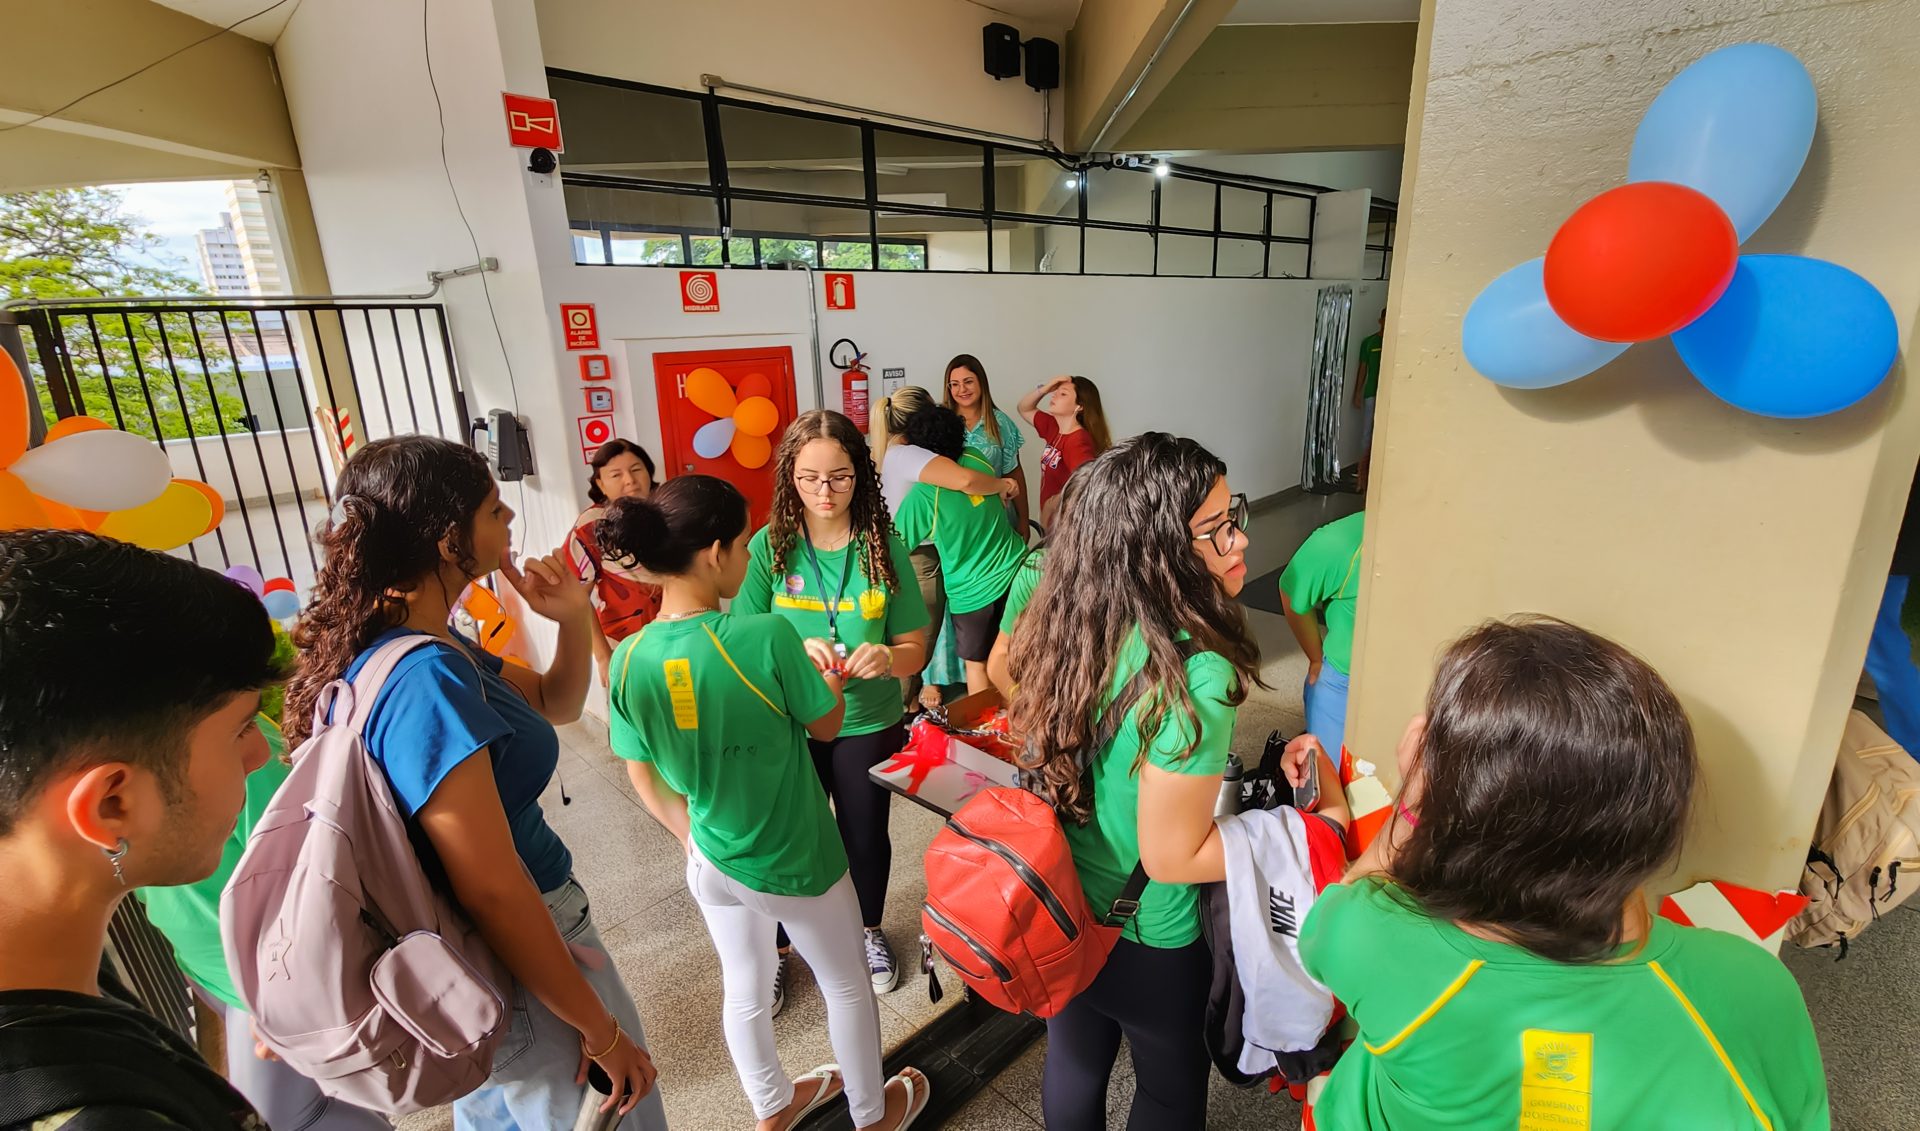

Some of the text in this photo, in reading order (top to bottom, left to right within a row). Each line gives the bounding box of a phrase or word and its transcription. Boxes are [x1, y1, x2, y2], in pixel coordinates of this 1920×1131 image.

[884, 369, 904, 378] AVISO
[1269, 885, 1298, 939] NIKE
[1530, 1099, 1585, 1113] GOVERNO
[1523, 1111, 1540, 1120] DO
[1542, 1112, 1588, 1127] ESTADO
